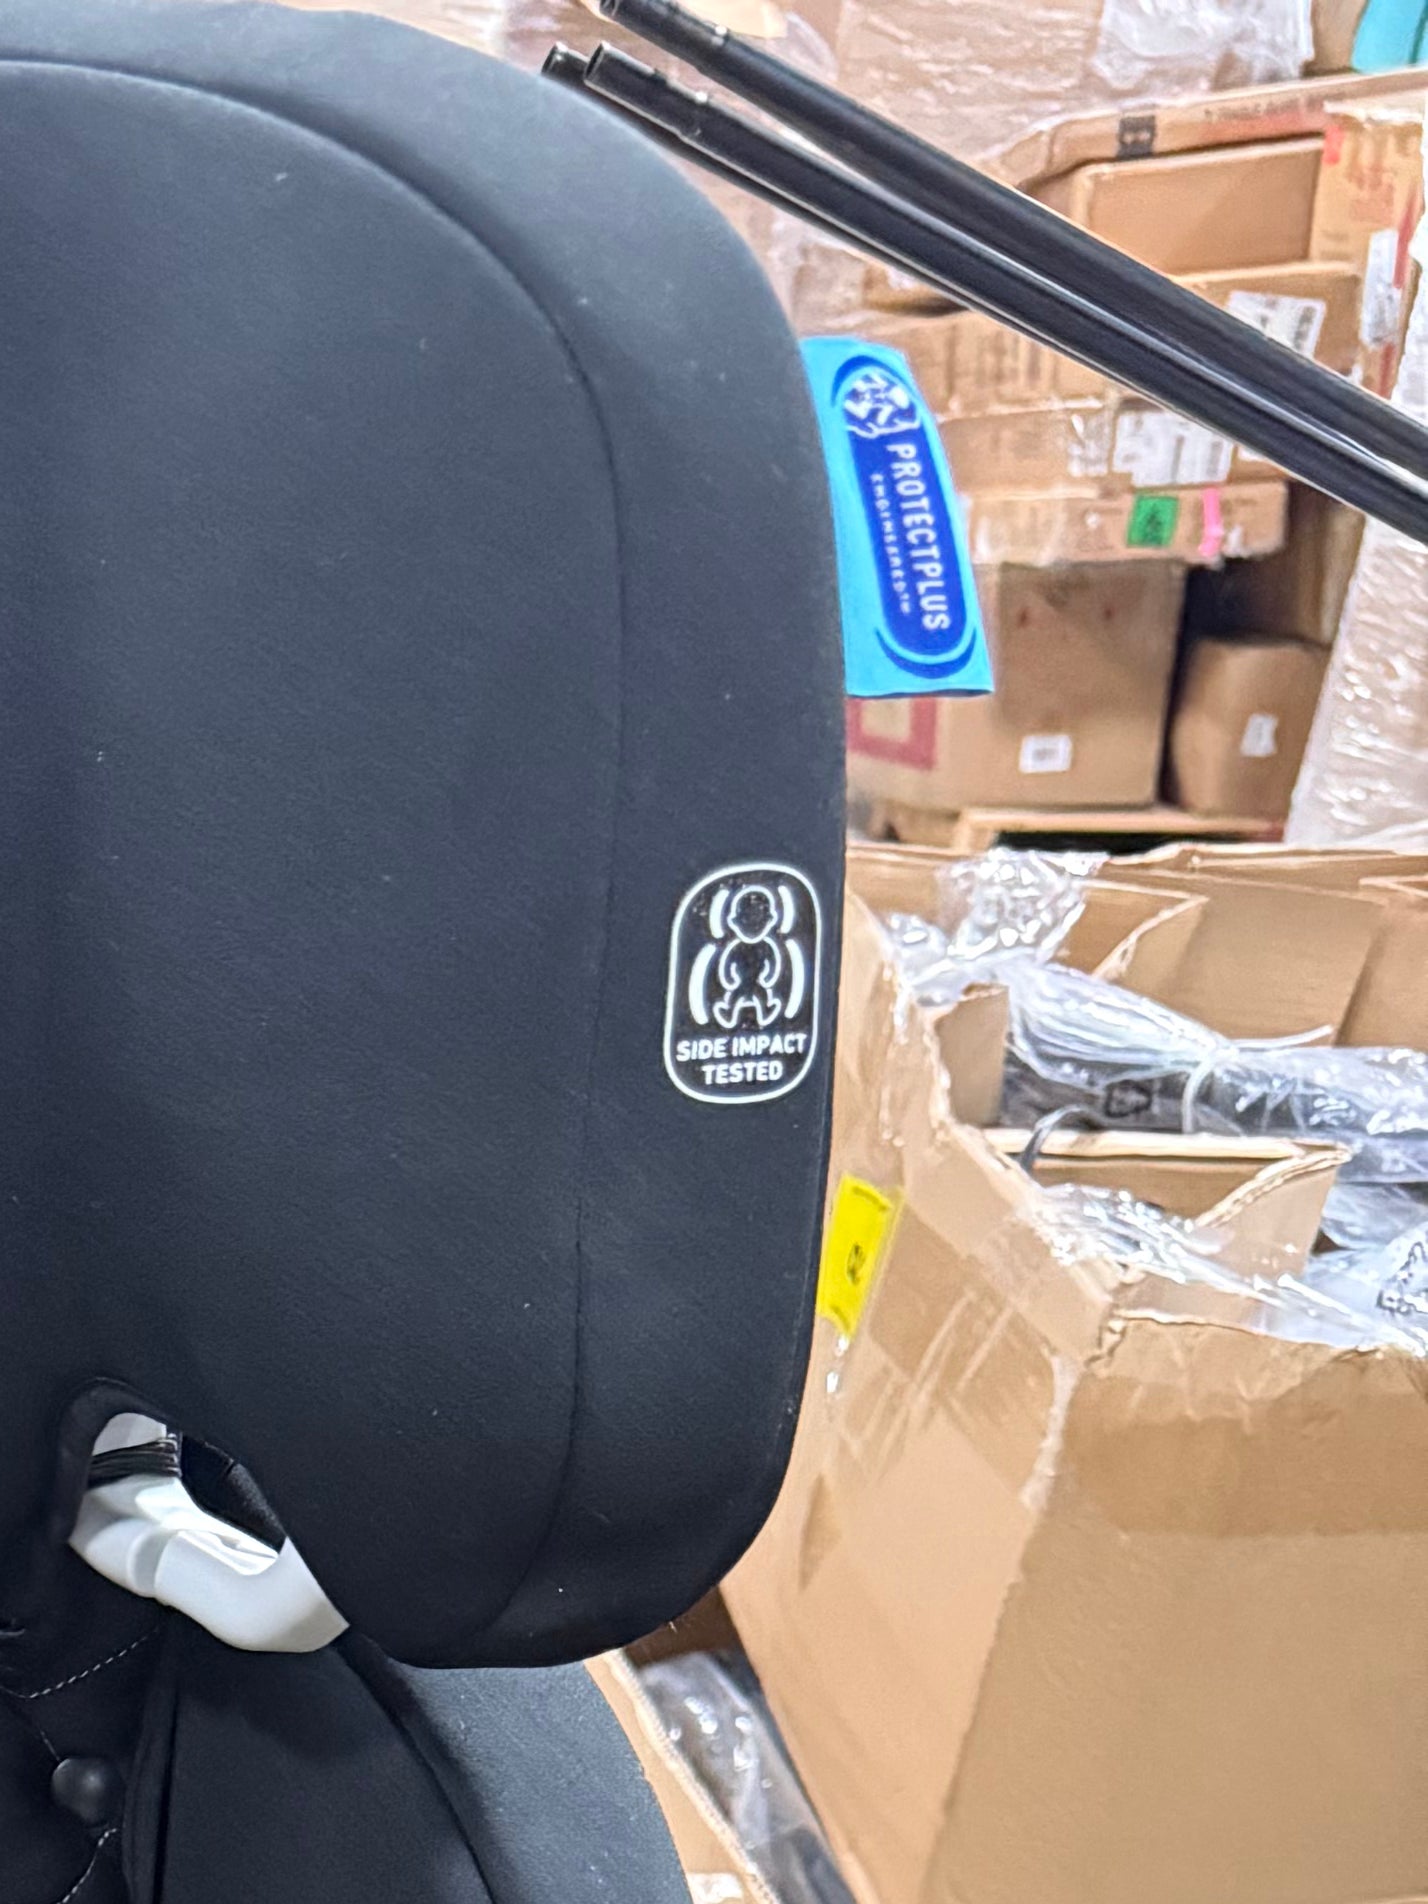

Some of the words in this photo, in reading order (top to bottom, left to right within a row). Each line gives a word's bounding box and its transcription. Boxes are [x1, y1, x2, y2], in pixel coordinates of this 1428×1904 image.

[886, 444, 951, 630] PROTECTPLUS
[676, 1039, 727, 1061] SIDE
[732, 1034, 807, 1057] IMPACT
[702, 1061, 783, 1085] TESTED
